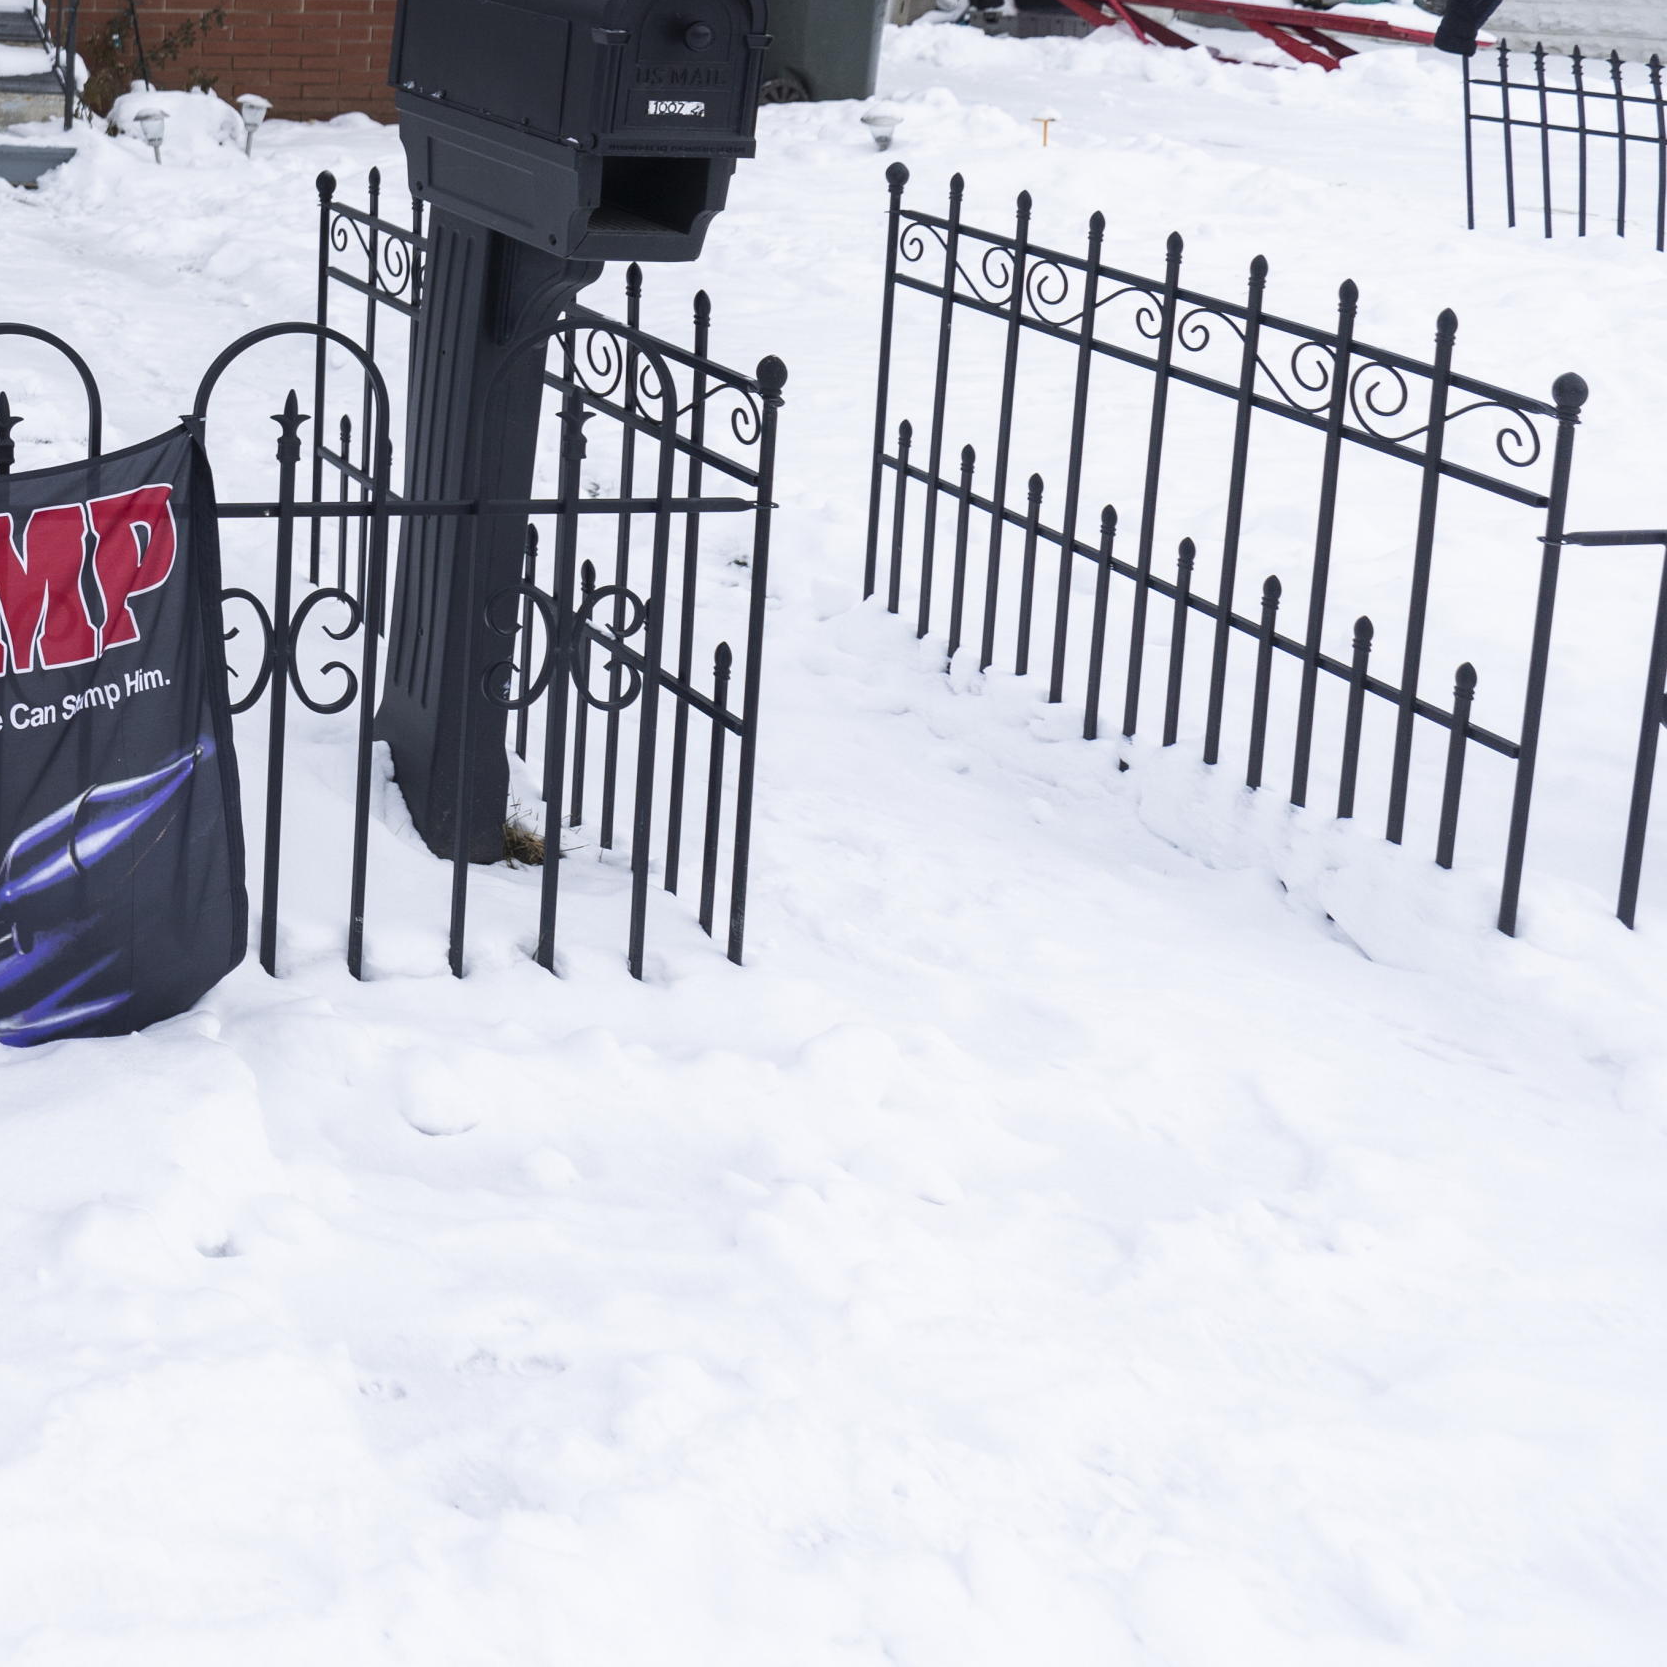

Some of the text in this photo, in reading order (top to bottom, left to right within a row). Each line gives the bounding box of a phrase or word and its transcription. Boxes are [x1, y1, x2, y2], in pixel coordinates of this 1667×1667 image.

[670, 67, 727, 84] MAIL
[653, 101, 685, 115] 1007
[9, 703, 57, 730] Can
[124, 668, 171, 697] Him.
